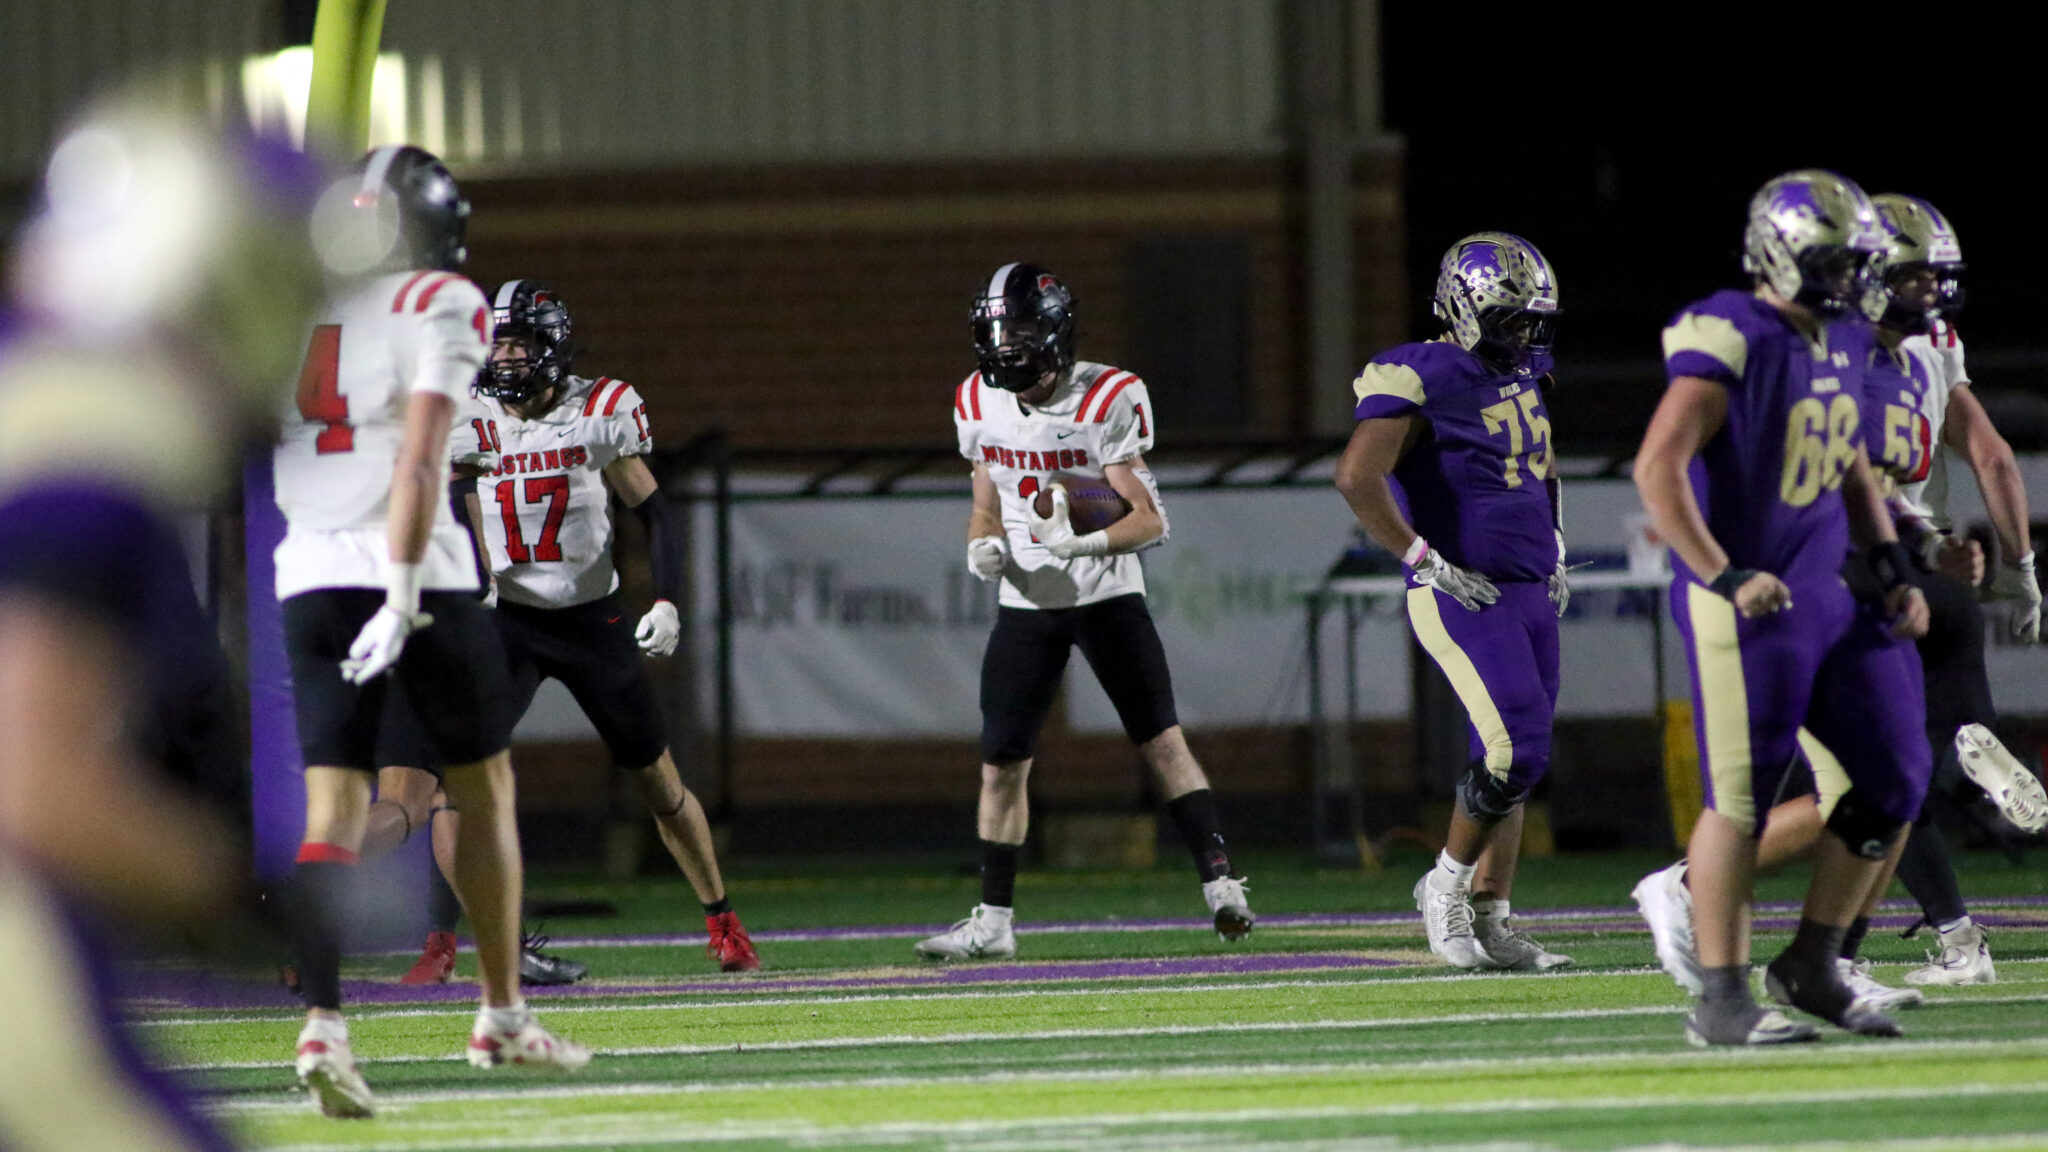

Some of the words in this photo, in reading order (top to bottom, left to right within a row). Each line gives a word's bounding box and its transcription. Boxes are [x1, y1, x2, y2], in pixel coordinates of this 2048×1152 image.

[296, 324, 355, 455] 4
[1134, 403, 1149, 439] 1
[1480, 388, 1552, 489] 75
[483, 444, 587, 477] STANGS
[980, 445, 1088, 471] MUSTANGS
[495, 477, 570, 564] 17
